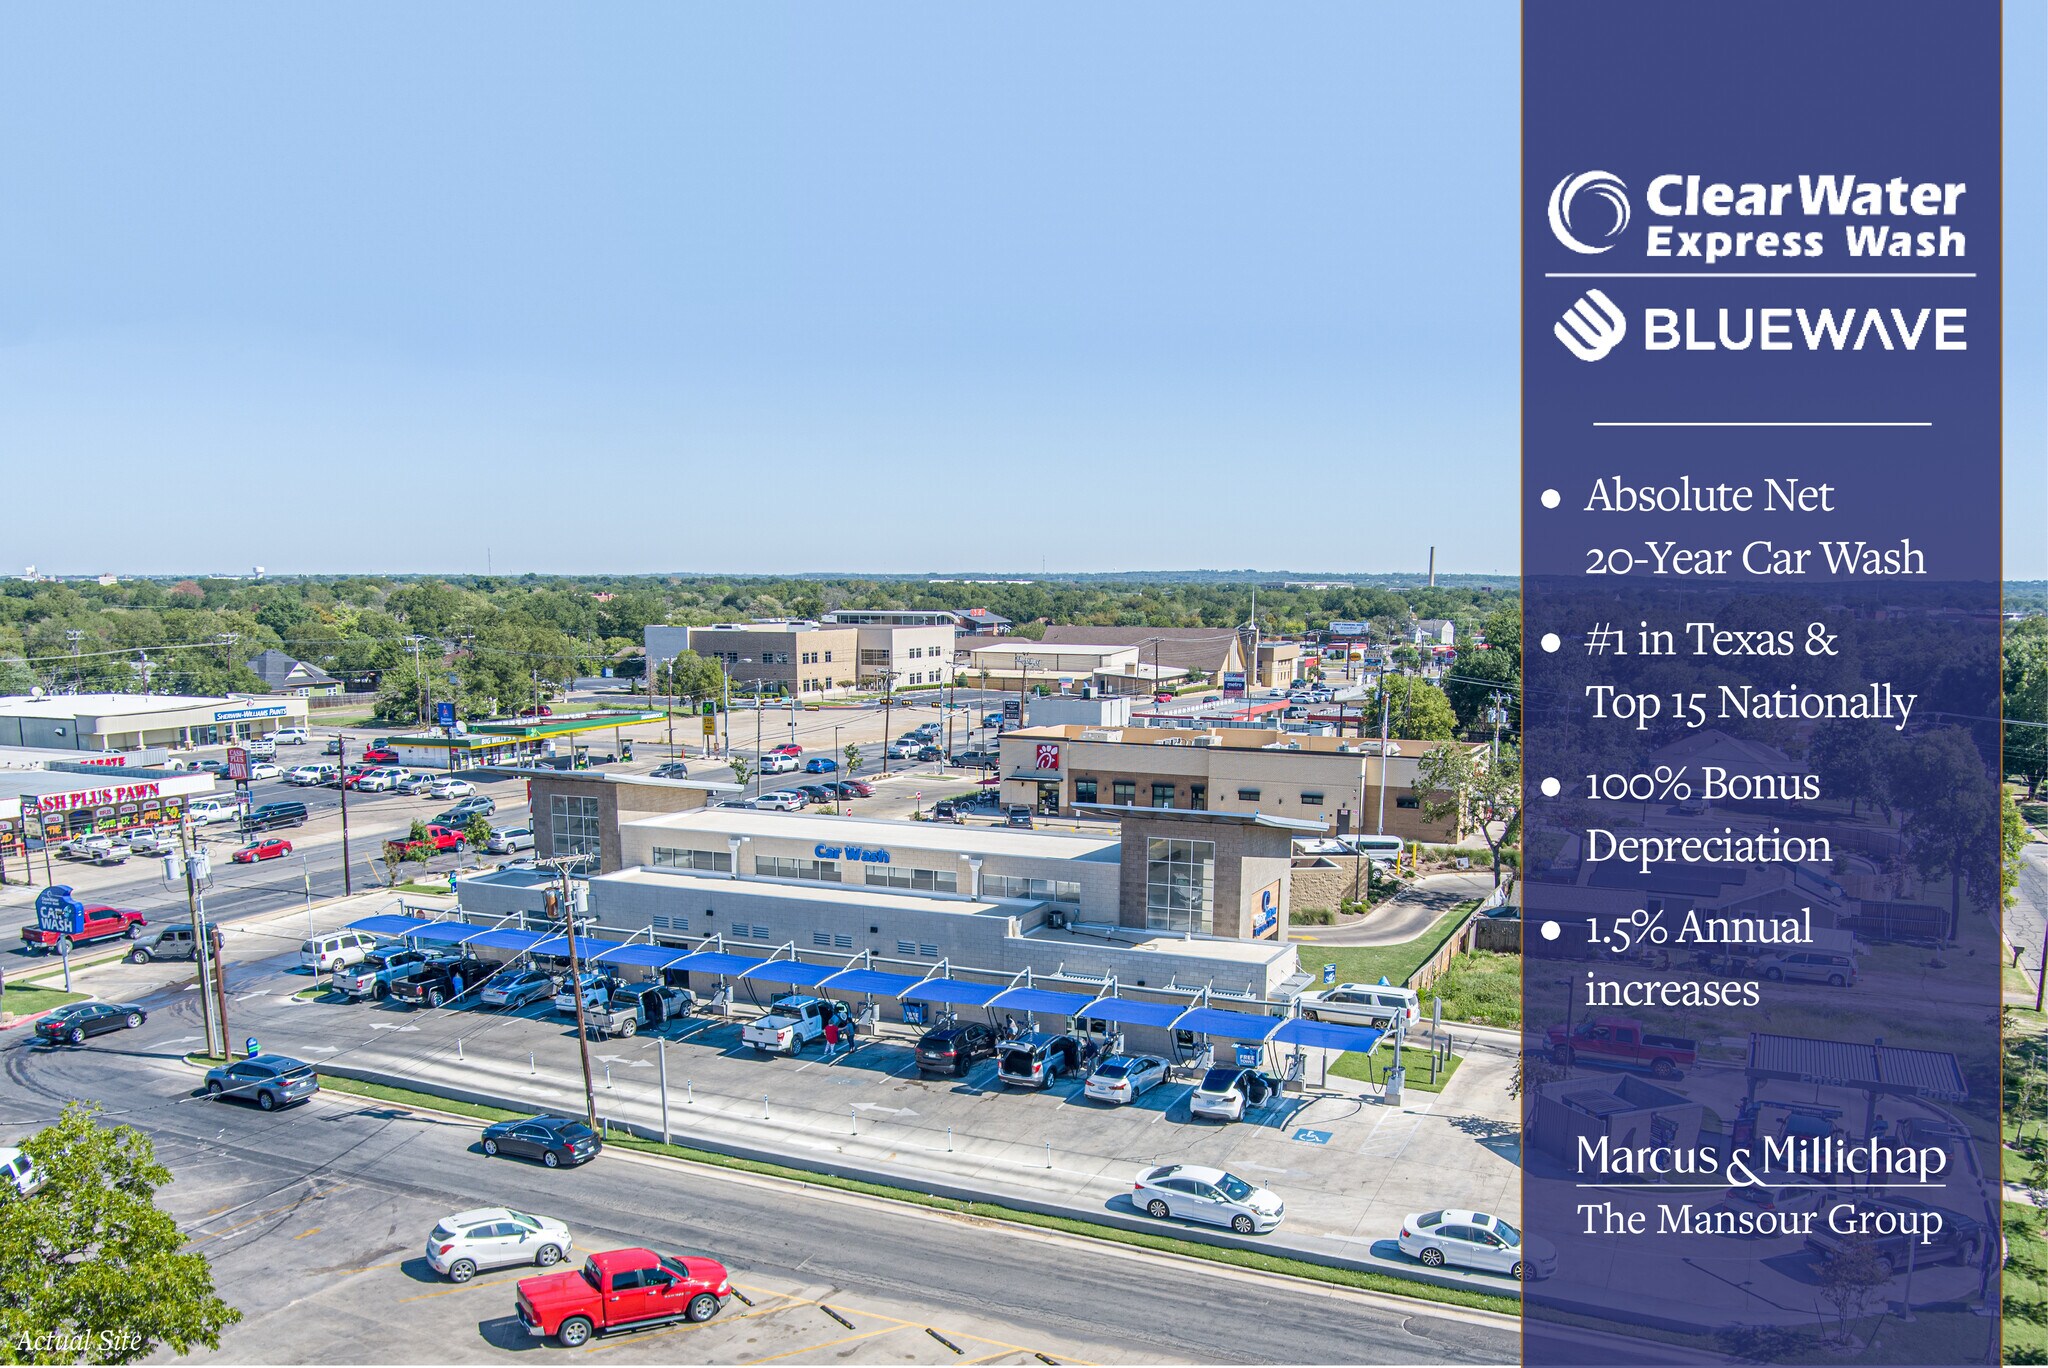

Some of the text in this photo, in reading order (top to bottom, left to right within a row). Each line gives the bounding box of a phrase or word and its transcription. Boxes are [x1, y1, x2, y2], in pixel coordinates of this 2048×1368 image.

[229, 763, 247, 778] PAWN
[70, 789, 113, 808] PLUS
[115, 783, 160, 802] PAWN
[814, 844, 891, 864] Car Wash
[41, 918, 72, 932] WASH
